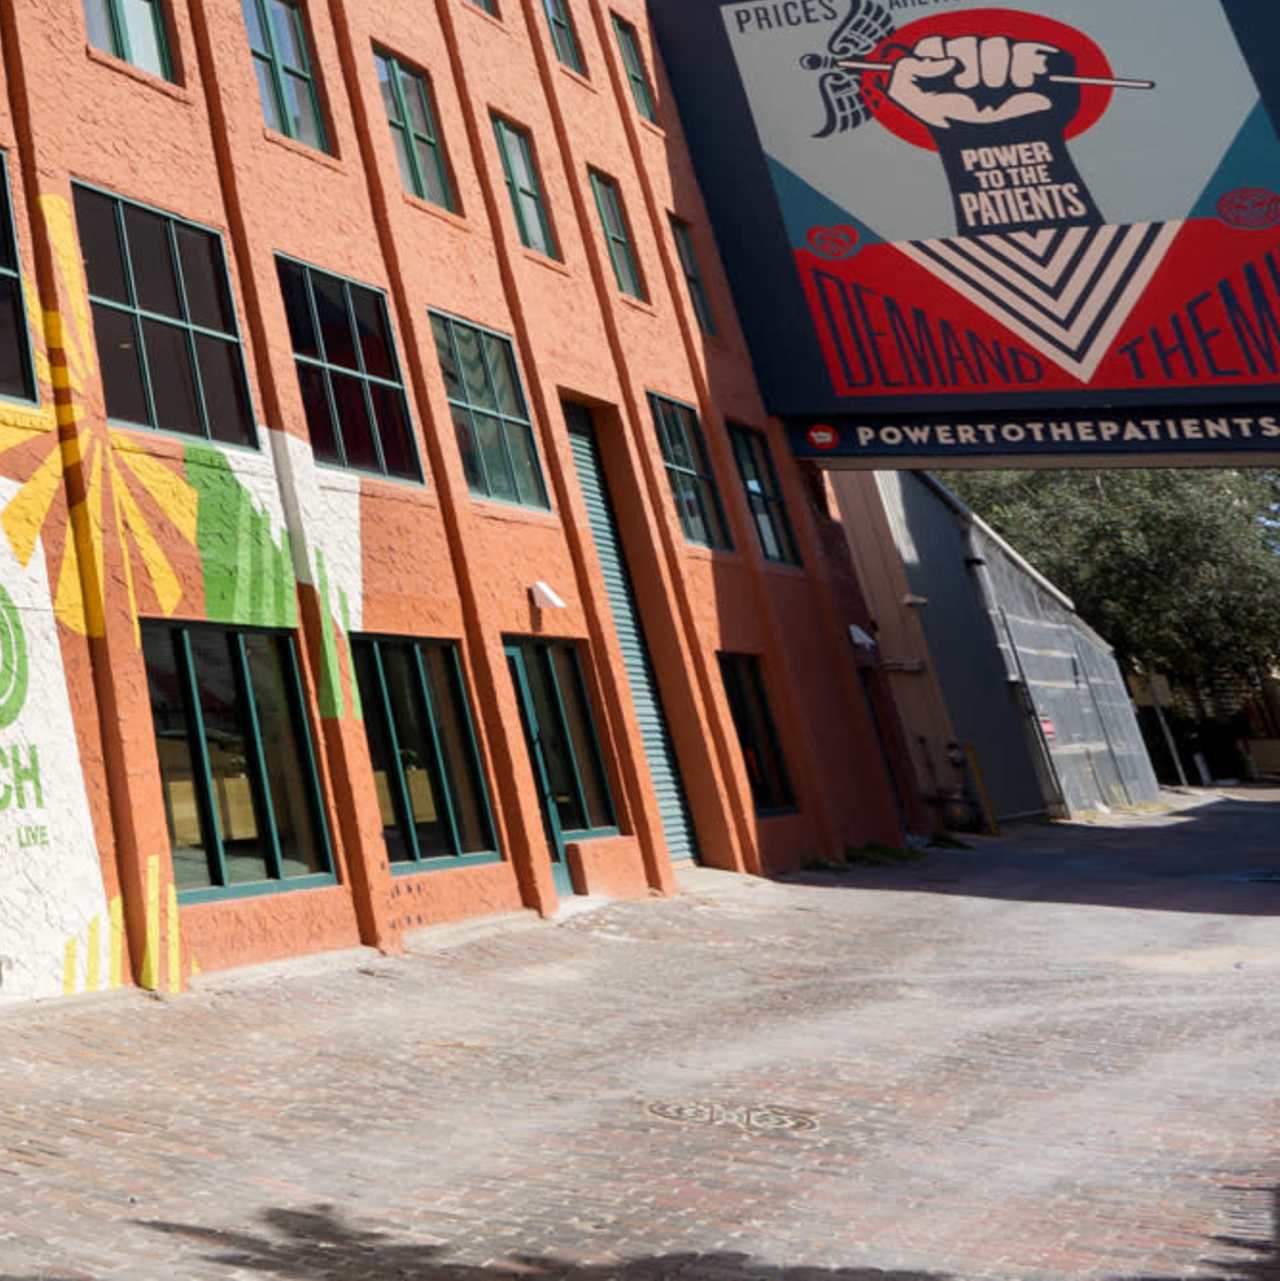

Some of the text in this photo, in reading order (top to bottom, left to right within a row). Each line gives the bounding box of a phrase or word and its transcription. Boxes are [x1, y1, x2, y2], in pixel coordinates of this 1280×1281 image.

[960, 141, 1054, 171] POWER
[974, 164, 1052, 189] TO THE
[958, 182, 1087, 227] PATIENTS
[811, 267, 1044, 388] DEMAND
[17, 824, 50, 849] LIVE
